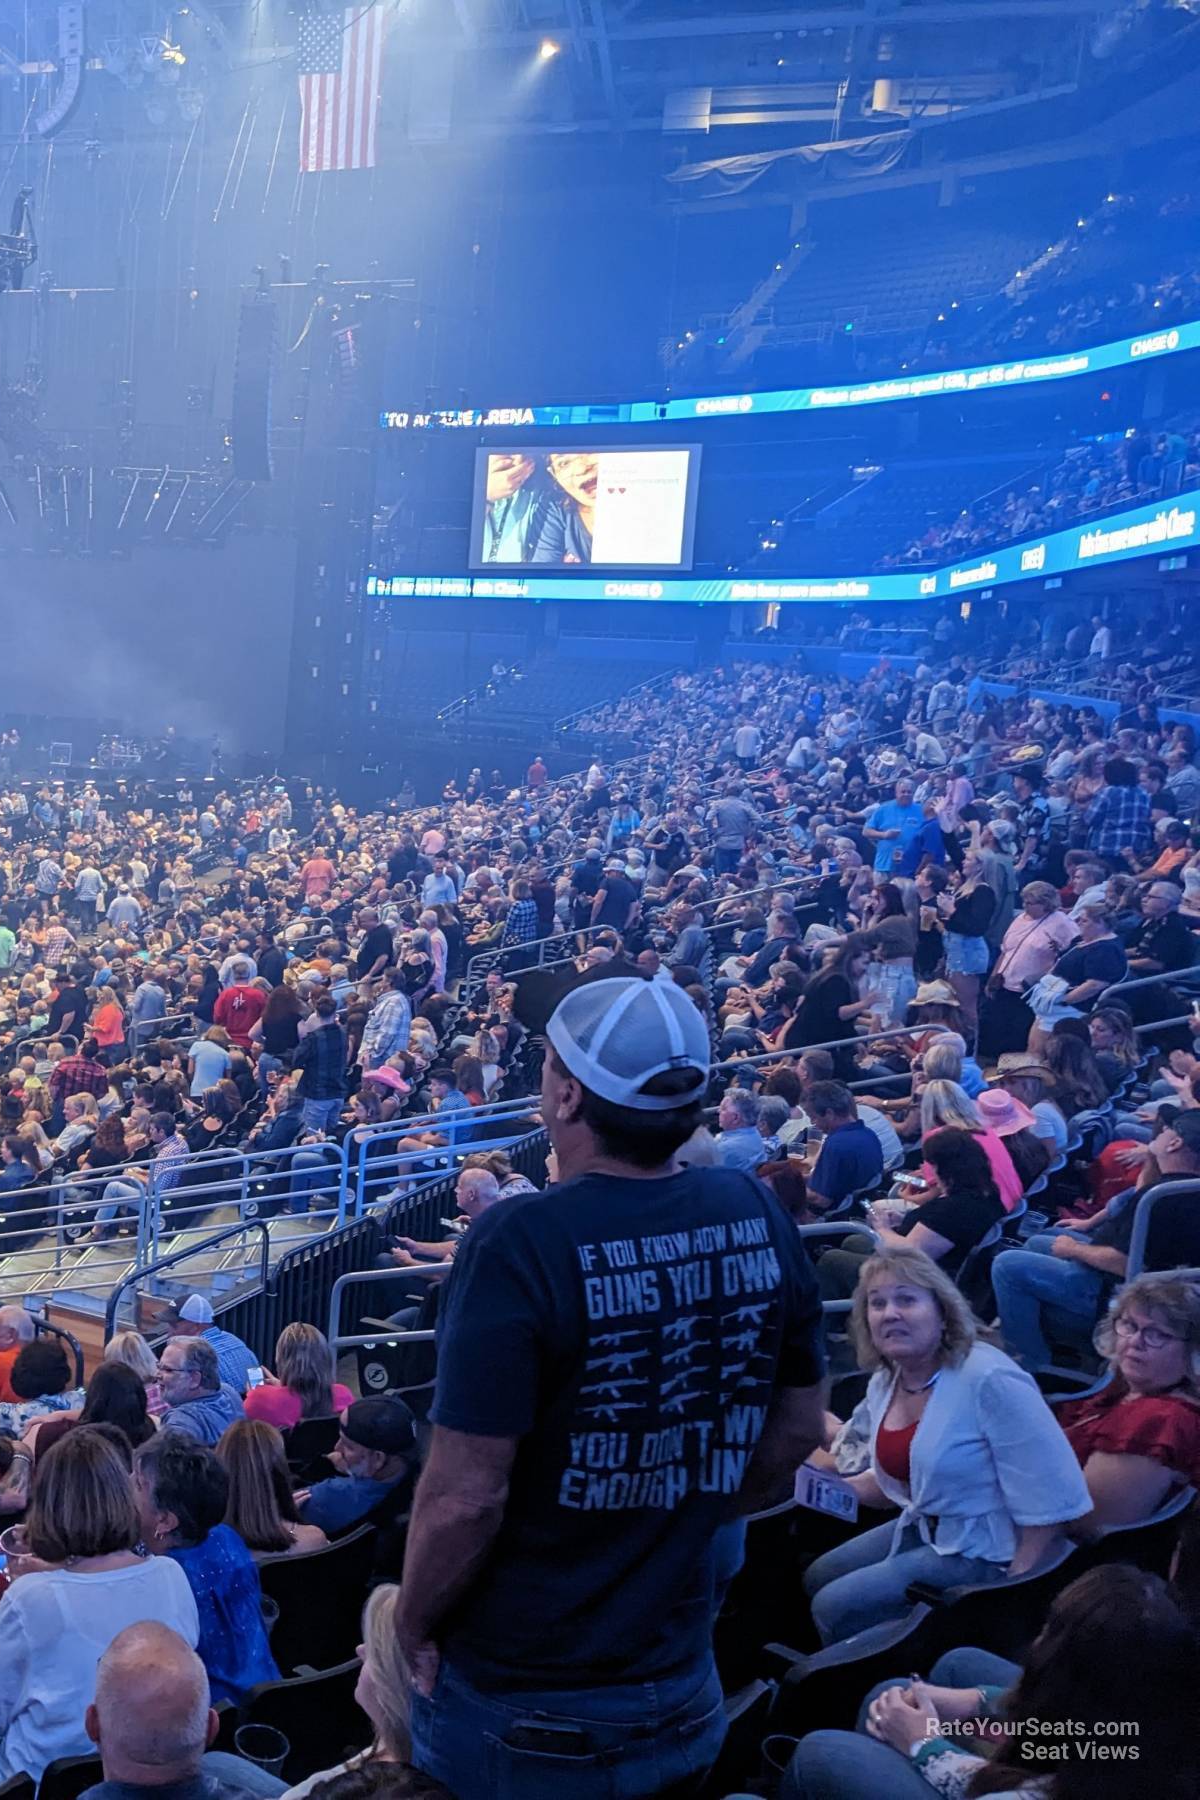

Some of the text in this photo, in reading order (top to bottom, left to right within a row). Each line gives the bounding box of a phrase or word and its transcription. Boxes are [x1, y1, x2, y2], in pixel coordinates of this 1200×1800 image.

[1130, 335, 1167, 358] CHASE
[695, 397, 739, 414] CHASE
[604, 583, 650, 597] CHASE
[578, 1217, 770, 1272] IF YOU KNOW HOW MANY
[583, 1246, 782, 1320] GUNS YOU OWN
[569, 1432, 629, 1470] YOU
[639, 1420, 715, 1468] DON'T
[558, 1464, 689, 1511] ENOUGH
